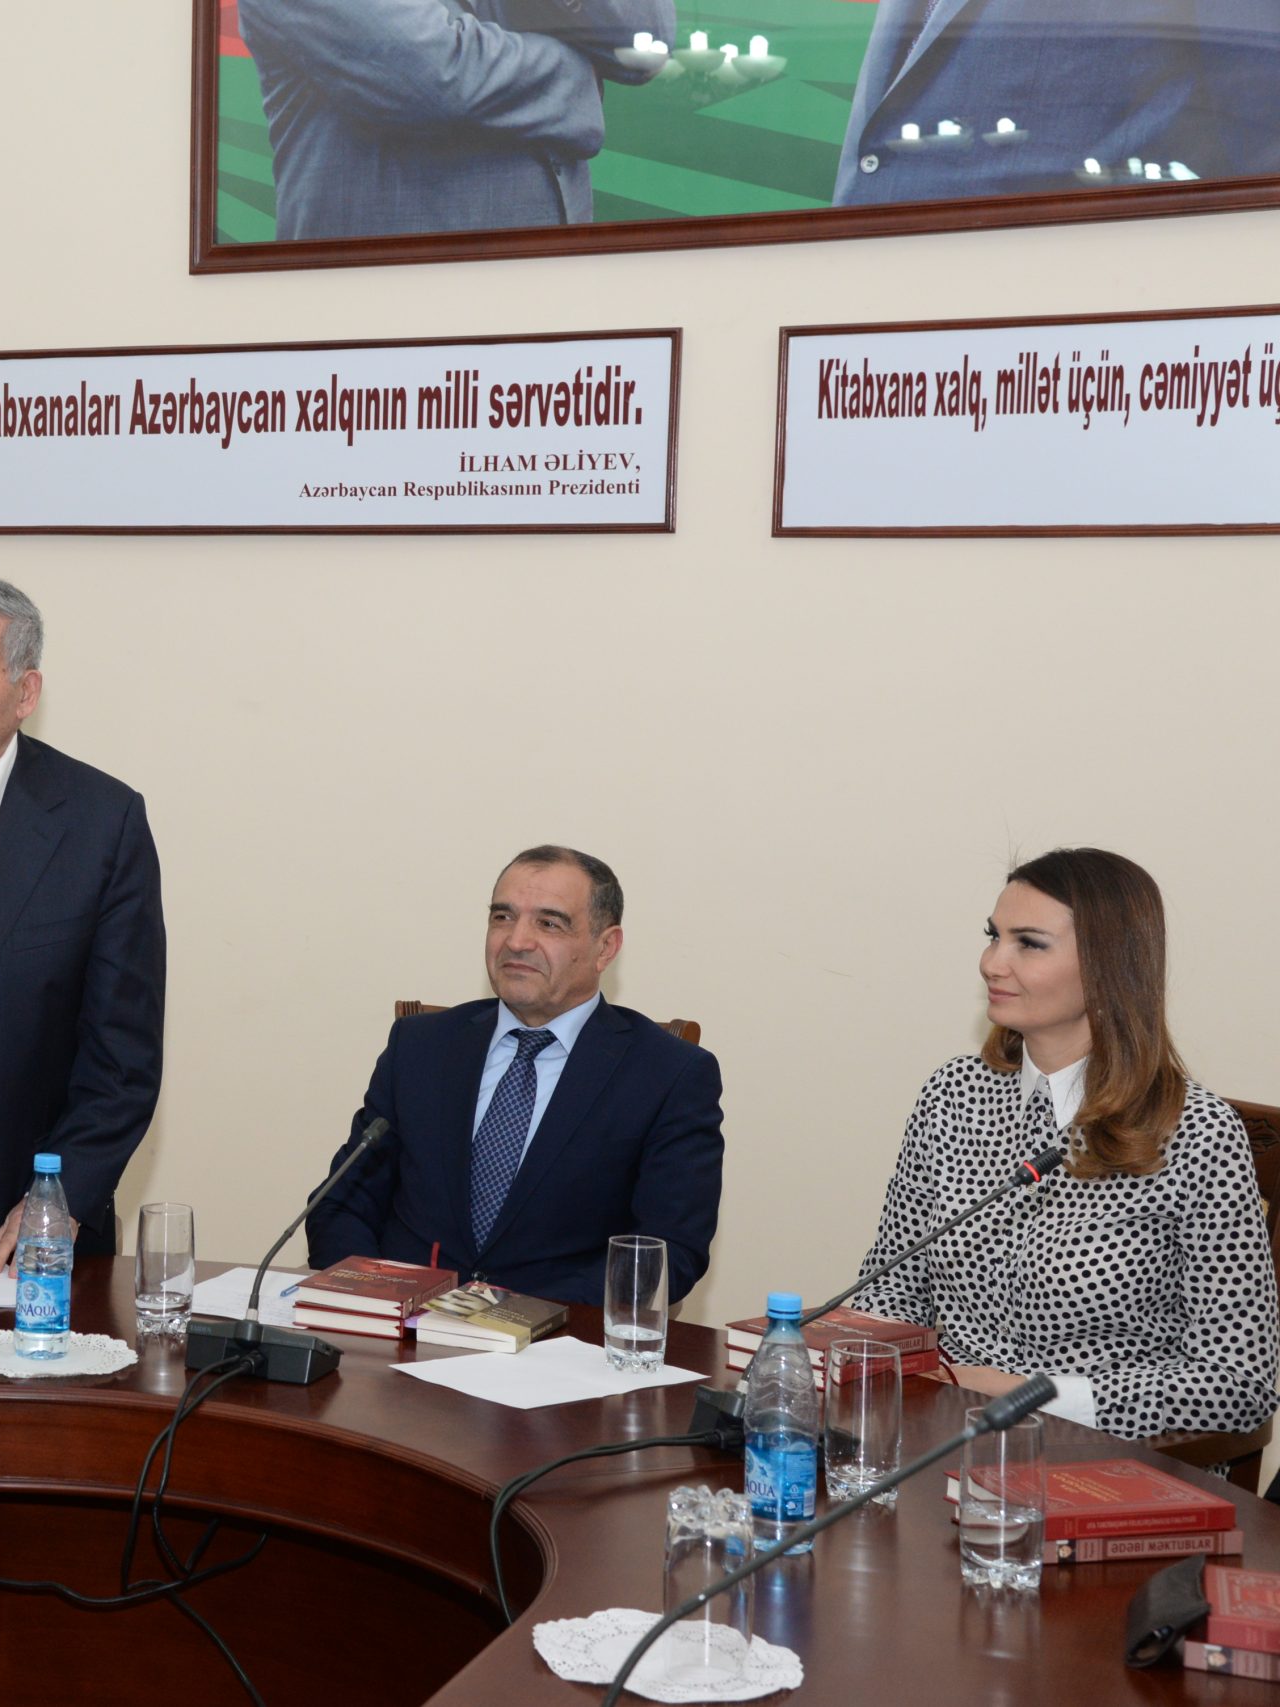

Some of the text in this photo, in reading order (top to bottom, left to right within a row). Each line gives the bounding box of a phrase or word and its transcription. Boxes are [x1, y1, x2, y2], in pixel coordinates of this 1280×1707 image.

[817, 357, 927, 419] Kitabxana
[933, 354, 988, 432] xalq,
[995, 351, 1061, 415] millət
[1067, 349, 1131, 430] üçün,
[1139, 344, 1253, 428] cəmiyyət
[128, 377, 286, 449] Azərbaycan
[294, 373, 407, 446] xalqının
[417, 369, 479, 429] milli
[488, 364, 643, 429] sərvətidir.
[460, 449, 641, 473] İLHAM ƏLİYEV,
[299, 478, 640, 501] Azərbaycan Respublikasının Prezidenti
[1111, 1538, 1212, 1554] ƏDƏBİ MƏKTUBLAR
